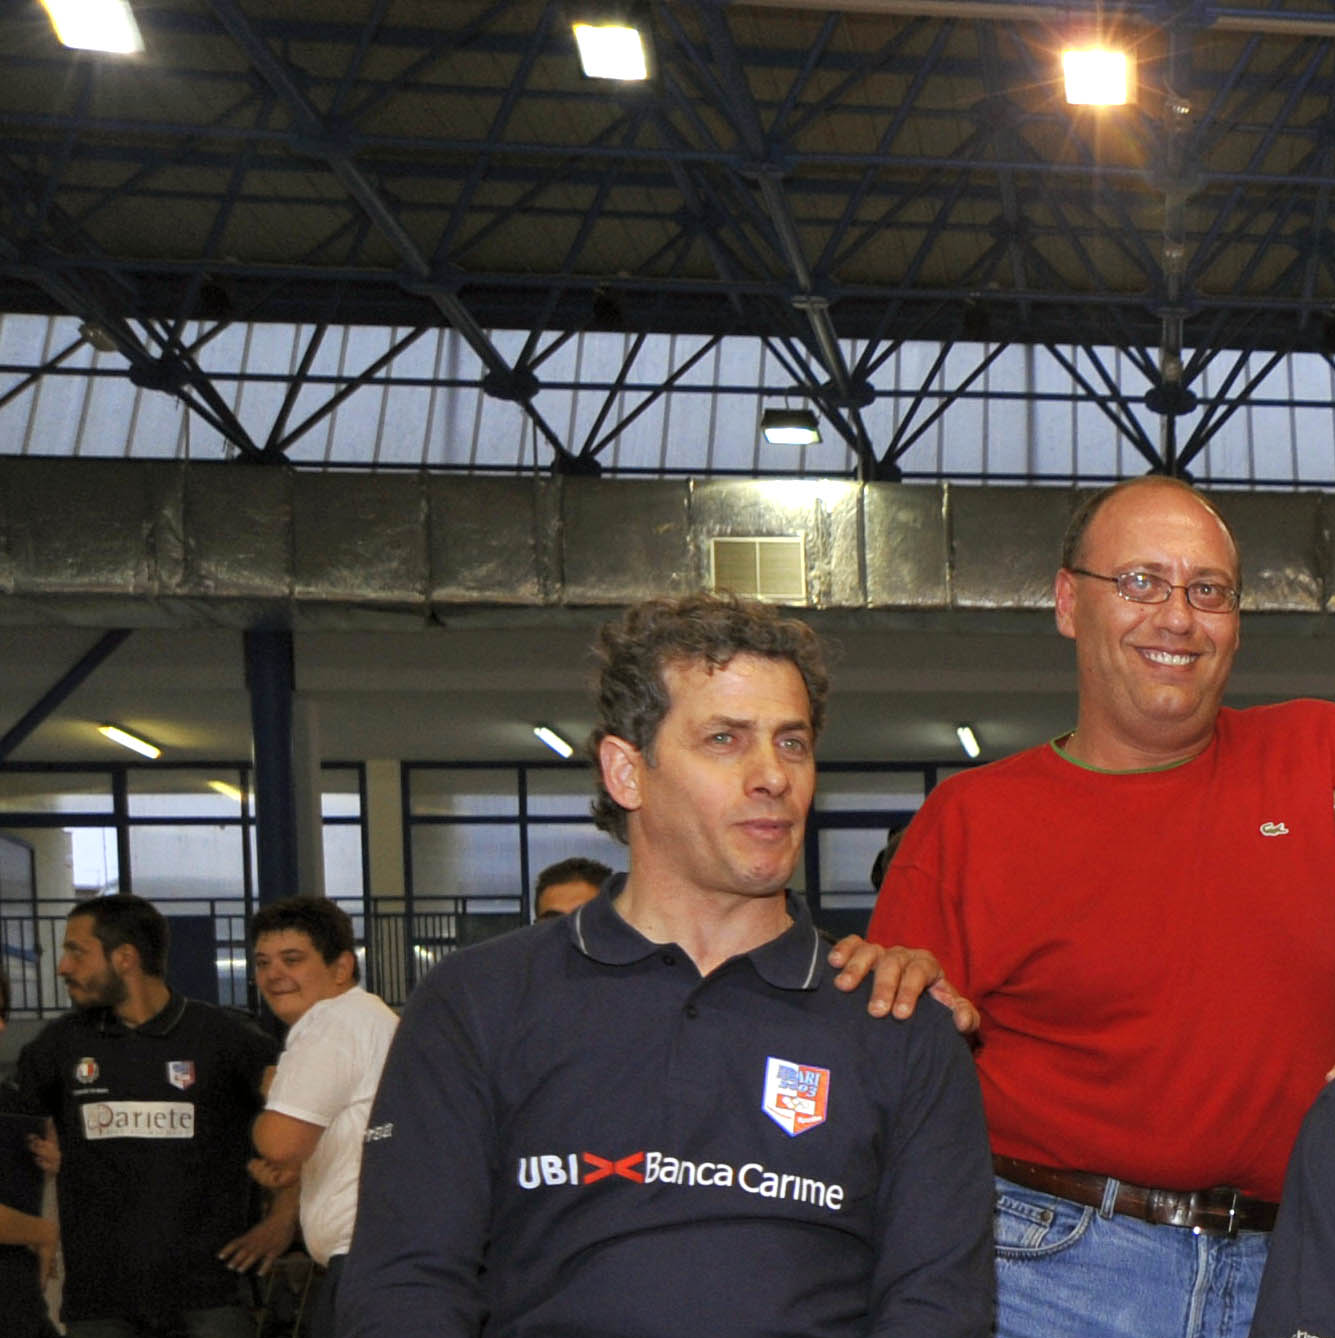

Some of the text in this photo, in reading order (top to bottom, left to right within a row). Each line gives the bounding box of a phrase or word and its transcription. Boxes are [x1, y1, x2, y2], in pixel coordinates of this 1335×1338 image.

[518, 1151, 844, 1210] UBI Banca Carime
